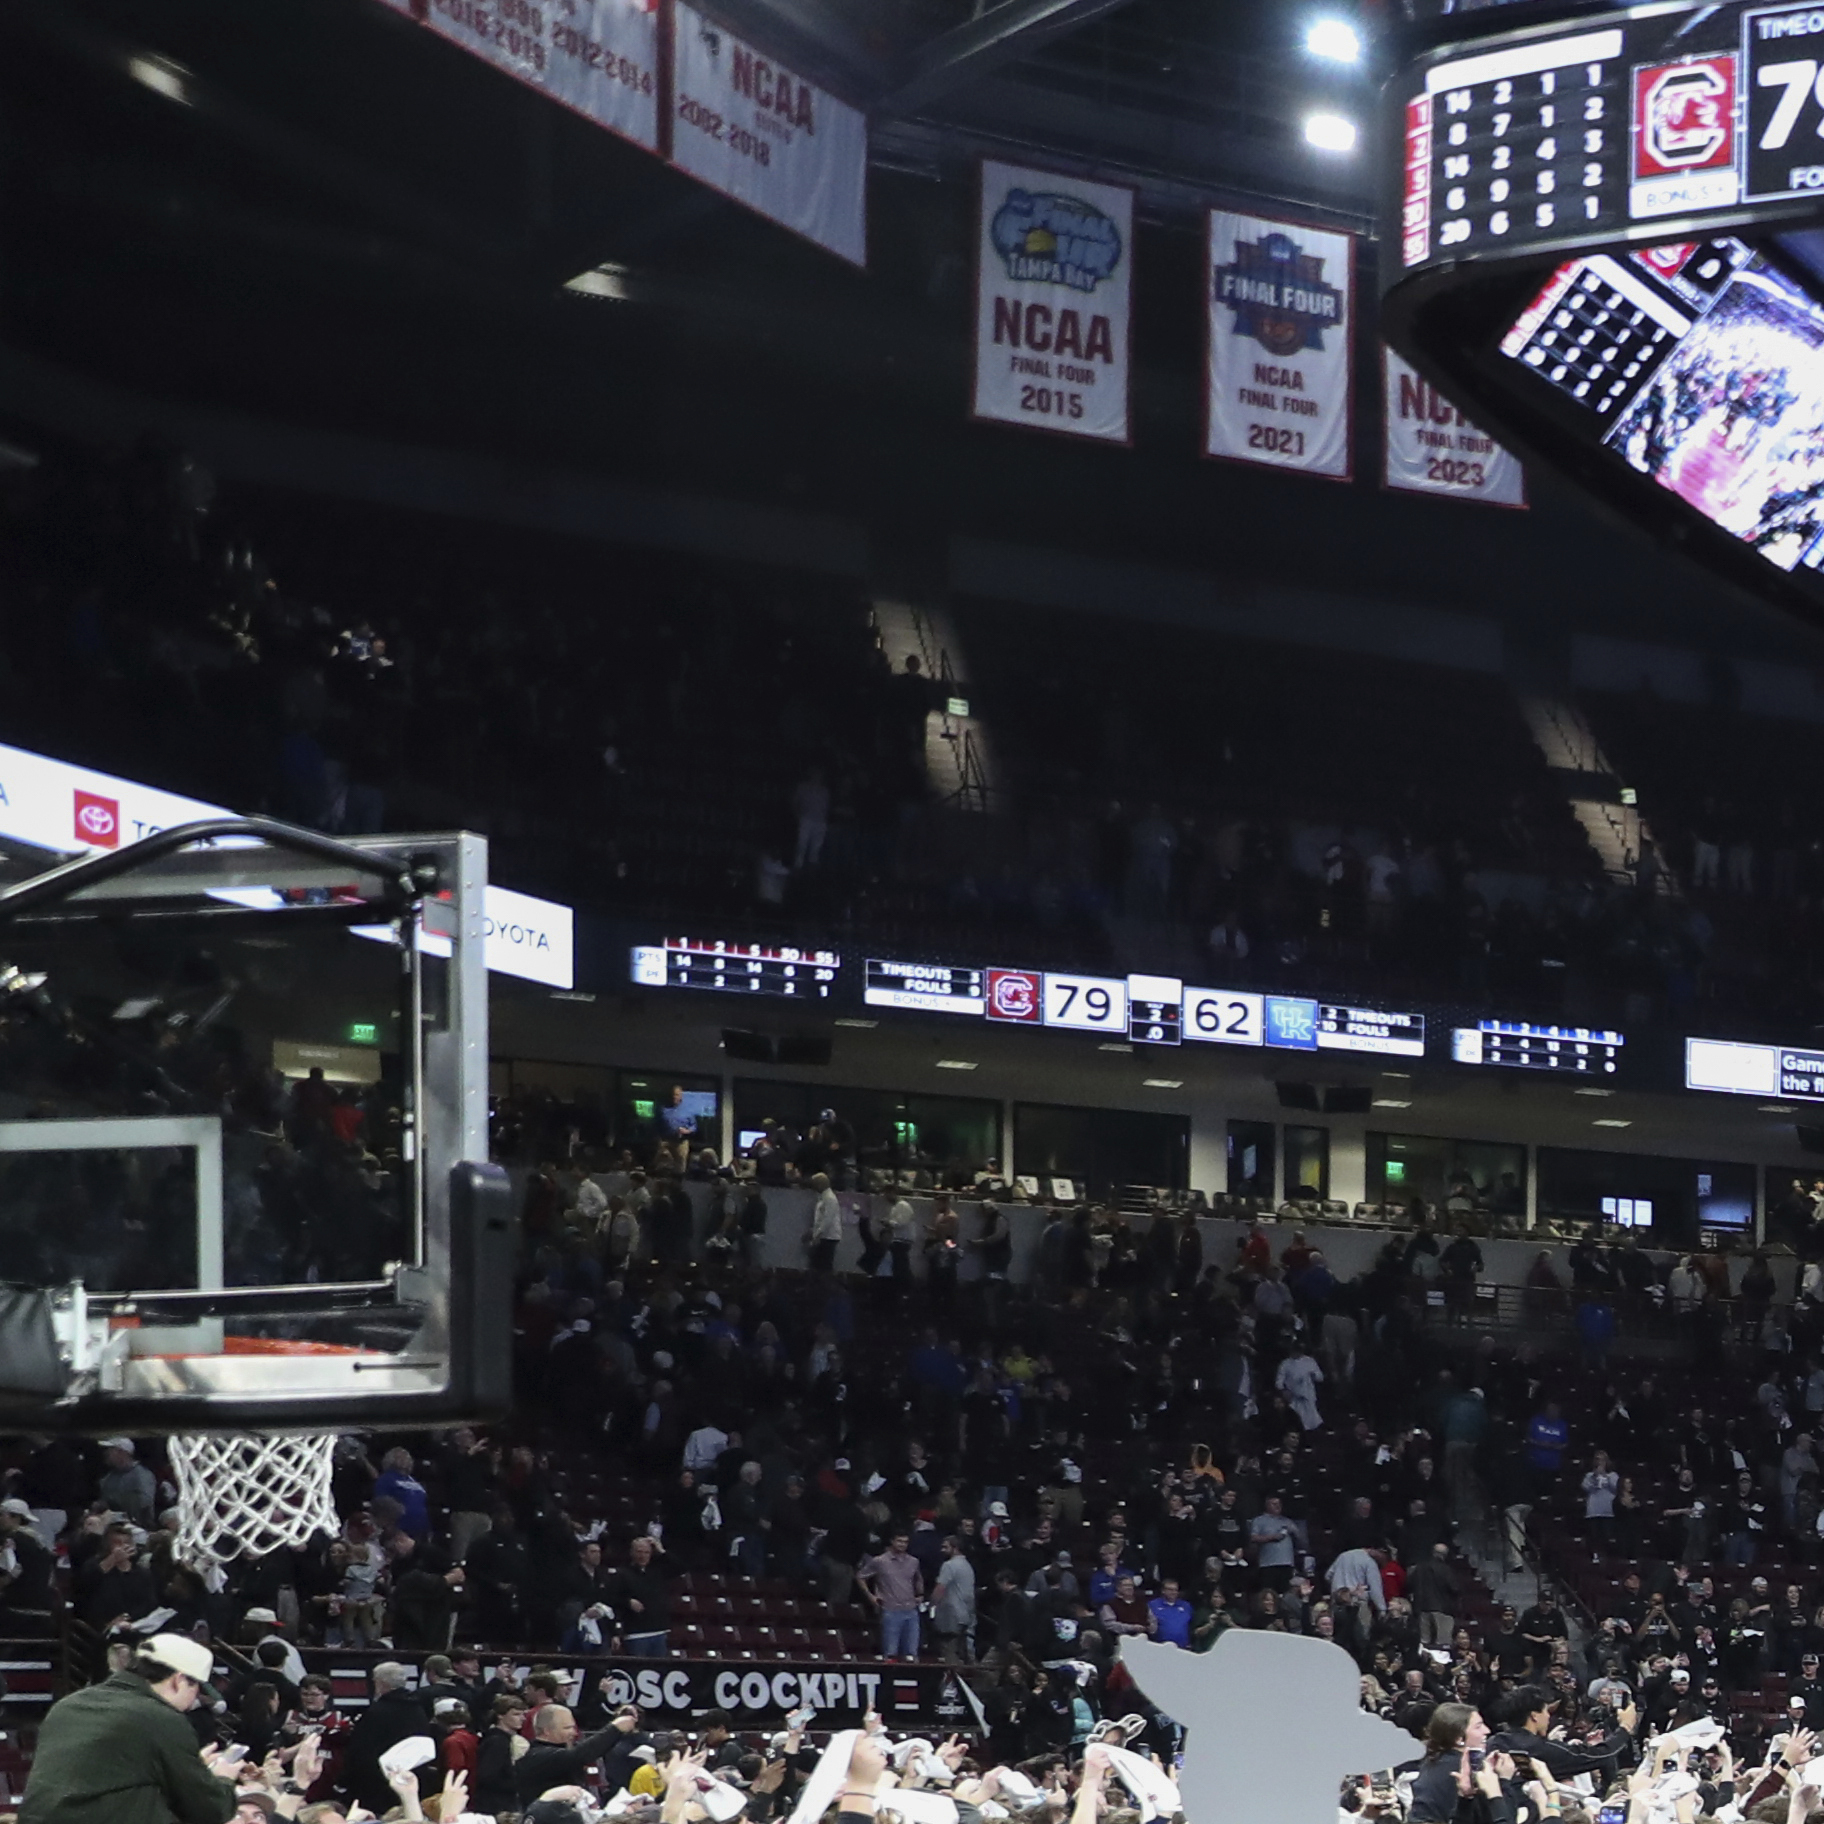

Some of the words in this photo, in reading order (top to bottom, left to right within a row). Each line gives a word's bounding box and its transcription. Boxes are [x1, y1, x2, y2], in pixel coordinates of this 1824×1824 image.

[733, 44, 815, 136] NCAA
[1493, 81, 1512, 104] 2
[1541, 72, 1554, 95] 1
[1587, 64, 1601, 86] 1
[1492, 113, 1511, 137] 7
[1540, 105, 1554, 127] 1
[1584, 97, 1603, 120] 2
[1009, 254, 1060, 282] TAMPA
[1061, 263, 1096, 289] BAY
[1223, 275, 1280, 307] FINAL
[1281, 284, 1337, 318] FOUR
[993, 296, 1114, 365] NCAA
[1010, 356, 1052, 379] FINAL
[1057, 364, 1096, 385] FOUR
[1254, 363, 1305, 392] NCAA
[1020, 384, 1083, 419] 2015
[1239, 388, 1279, 411] FINAL
[1283, 396, 1319, 418] FOUR
[1400, 374, 1465, 427] NC
[1249, 424, 1304, 456] 2021
[1416, 429, 1454, 449] FINAL
[1459, 436, 1494, 454] FOUR
[1427, 457, 1485, 486] 2023
[482, 917, 550, 951] OYOTA
[882, 962, 952, 981] TIMEOUTS
[970, 971, 980, 983] 3
[904, 980, 952, 995] FOULS
[969, 984, 980, 996] 9
[1054, 983, 1112, 1022] 79
[1194, 998, 1250, 1036] 62
[1327, 1008, 1338, 1020] 2
[1347, 1010, 1411, 1027] TIMEOUTS
[1321, 1020, 1337, 1032] 10
[1347, 1022, 1390, 1038] FOULS
[1782, 1075, 1810, 1091] the
[600, 1667, 883, 1718] @SC_COCKPIT
